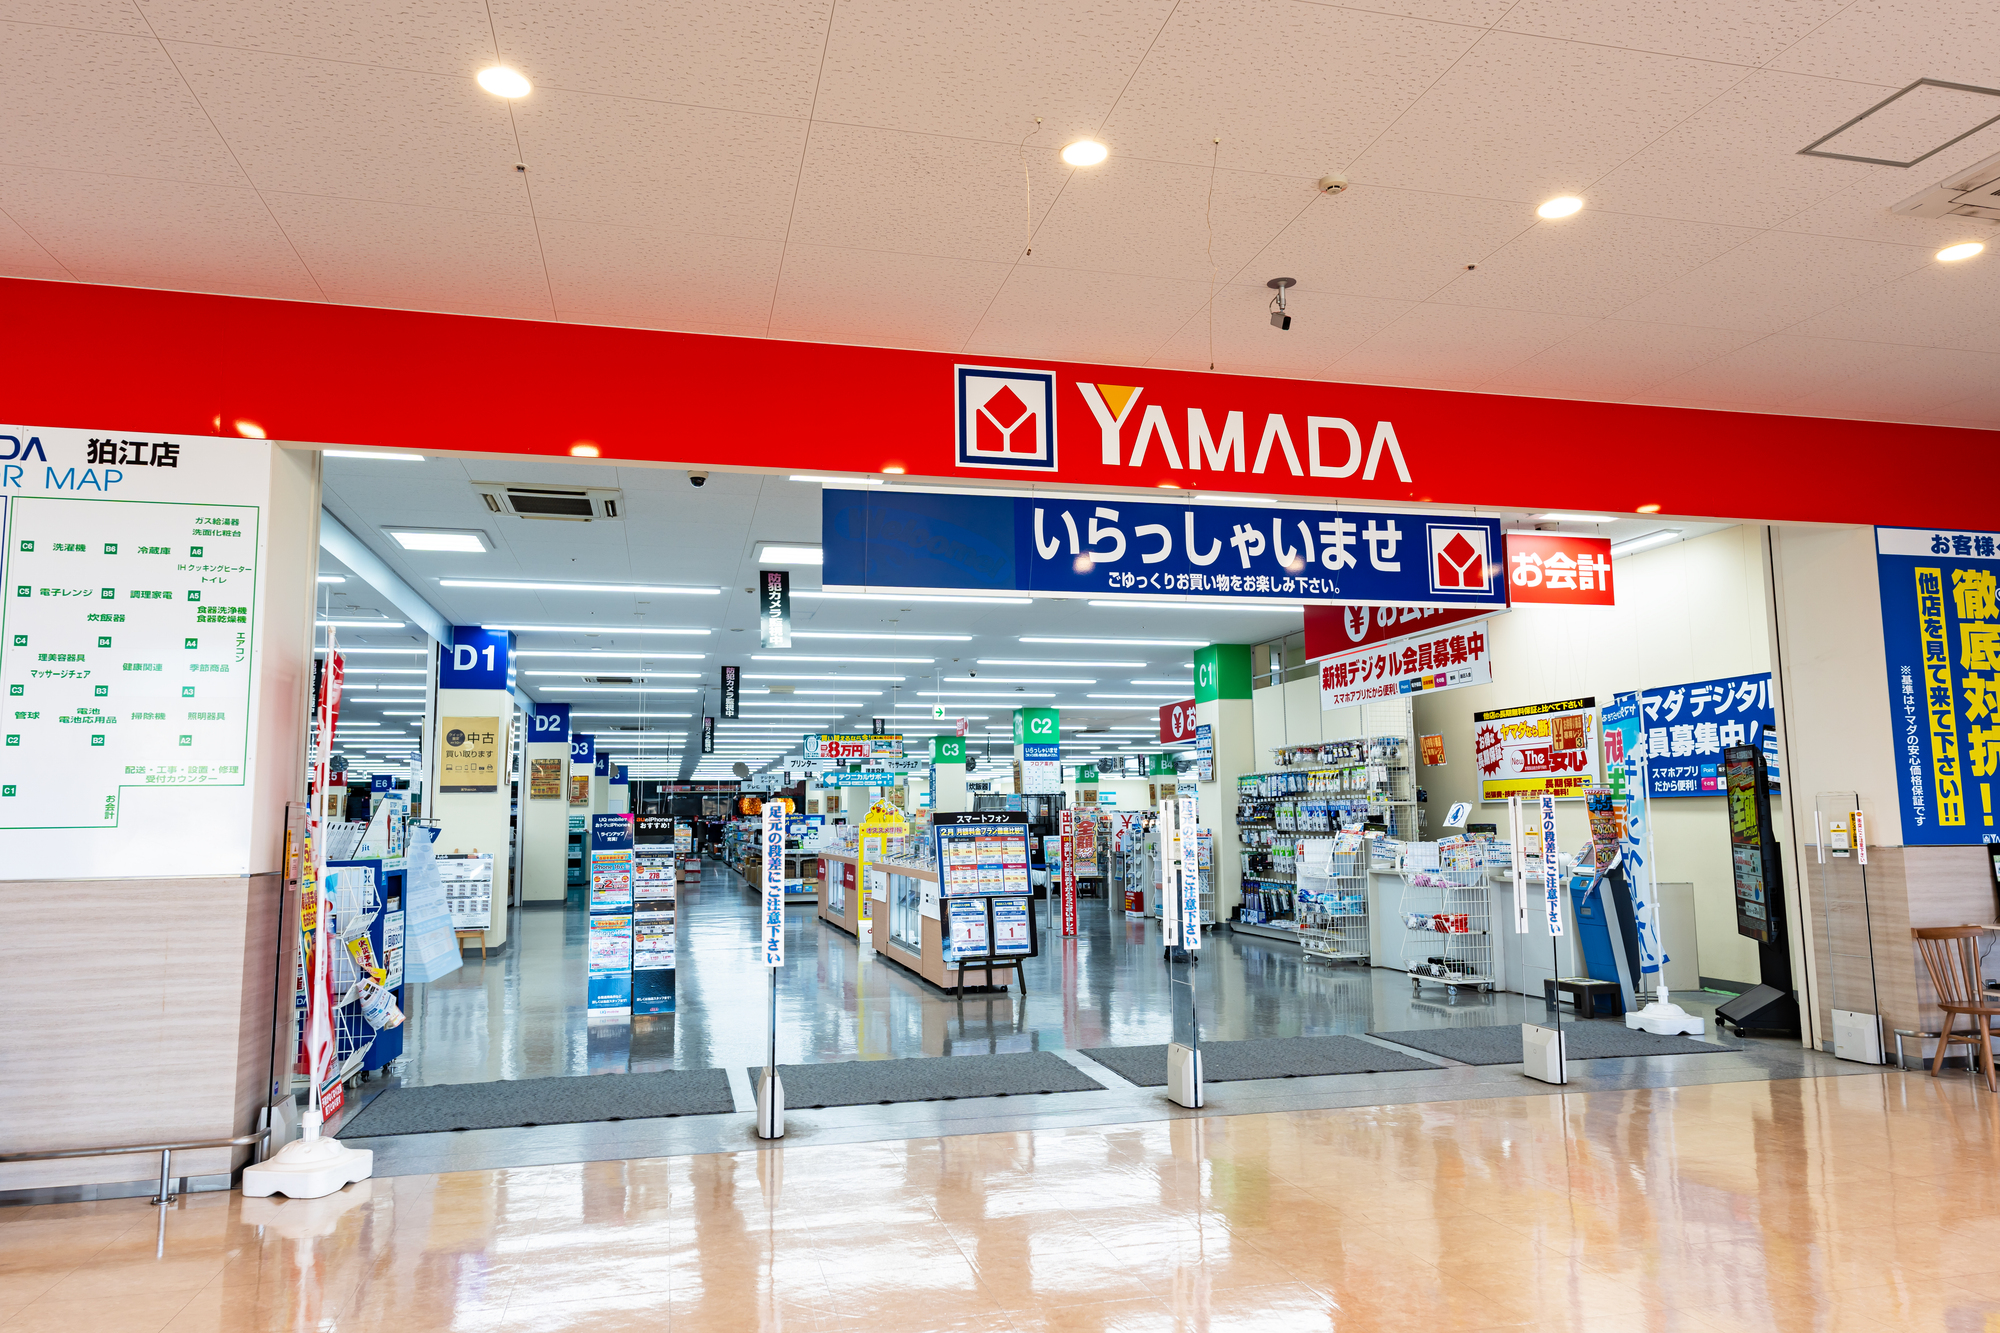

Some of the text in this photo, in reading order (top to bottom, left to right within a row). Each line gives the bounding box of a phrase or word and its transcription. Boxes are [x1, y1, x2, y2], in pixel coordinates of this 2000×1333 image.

[1076, 382, 1412, 483] YAMADA
[86, 438, 180, 468] 狛江店
[45, 466, 124, 491] MAP
[195, 517, 240, 526] ガス給湯器
[192, 528, 242, 538] 洗面化粧台
[1034, 506, 1402, 572] いらっしゃいませ
[22, 542, 34, 551] C6
[52, 542, 86, 553] 洗濯機
[105, 544, 116, 553] B6
[137, 546, 171, 556] 冷蔵庫
[191, 548, 202, 556] A6
[177, 564, 252, 574] IH クッキングヒーター
[1511, 551, 1611, 591] お会計
[201, 576, 227, 584] トイレ
[1108, 571, 1340, 595] ごゆっくりお買い物をお楽しみ下さい。
[18, 587, 30, 596] C5
[40, 588, 94, 598] 電子レンジ
[102, 589, 114, 598] B5
[130, 590, 173, 600] 調理家電
[189, 592, 200, 600] A5
[197, 606, 248, 615] 食器洗浄機
[767, 573, 784, 645] 防犯カメラ監視中
[87, 613, 126, 623] 炊飯器
[196, 615, 247, 624] 食器乾燥機
[14, 636, 26, 645] C4
[100, 638, 110, 647] B4
[186, 640, 197, 648] A4
[235, 632, 246, 663] エアコン
[38, 654, 86, 662] 理美容器具
[453, 644, 495, 671] D1
[1322, 630, 1484, 692] 新規デジタル会員募集中
[122, 663, 163, 672] 健康関連
[189, 664, 230, 673] 季節商品
[30, 669, 91, 680] マッサージチェア
[1200, 662, 1212, 688] C1
[11, 686, 23, 694] C3
[96, 687, 108, 696] B3
[183, 688, 194, 696] A3
[725, 667, 735, 718] 防犯カメラ監視中
[1334, 683, 1399, 705] スマホアプリだから便利!
[1637, 678, 1775, 722] マダデジタル
[1918, 572, 1960, 822] 他店を見て来て下さい!!
[1482, 700, 1584, 720] 他店の長期無料保証と比べて下さい!
[14, 711, 40, 720] 管球
[58, 716, 118, 724] 電池応用品
[131, 712, 166, 721] 掃除機
[187, 712, 226, 721] 照明器具
[535, 715, 561, 732] D2
[1030, 718, 1053, 734] C2
[7, 736, 19, 744] C2
[92, 736, 104, 745] B2
[180, 736, 191, 744] A2
[467, 732, 494, 744] 中古
[821, 734, 872, 742] 買い替えるなら今!
[1478, 732, 1496, 750] お得な
[1576, 738, 1582, 748] 3
[570, 742, 588, 755] D3
[942, 744, 959, 756] C3
[1900, 665, 1926, 827] ※基準はヤマダの安心価格保証です
[446, 750, 494, 758] 買い取ります
[1438, 754, 1444, 762] 4
[1477, 744, 1504, 770] 長期保証
[1524, 750, 1546, 765] The
[790, 760, 817, 768] プリンター
[1161, 760, 1174, 770] B4
[124, 765, 240, 774] 配送・工事・設置・修理
[1084, 770, 1096, 778] B5
[1652, 766, 1699, 779] スマホアプリ
[145, 775, 218, 784] 受付カウンター
[375, 779, 388, 788] E6
[4, 786, 16, 795] C1
[968, 782, 988, 791] 炊飯器
[1654, 779, 1698, 792] だから便利!
[104, 795, 116, 820] お会計
[956, 814, 1010, 824] スマートフォン
[1062, 812, 1072, 834] 出口
[940, 828, 954, 836] 2月
[361, 844, 370, 852] jit
[1542, 798, 1560, 934] 足元の段差にご注意下さい
[1182, 800, 1198, 947] 足元の段差にご注意下さい
[604, 880, 612, 888] 2
[766, 805, 782, 964] 足元の段差にご注意下さい
[966, 928, 972, 939] 1
[1008, 927, 1014, 938] 1
